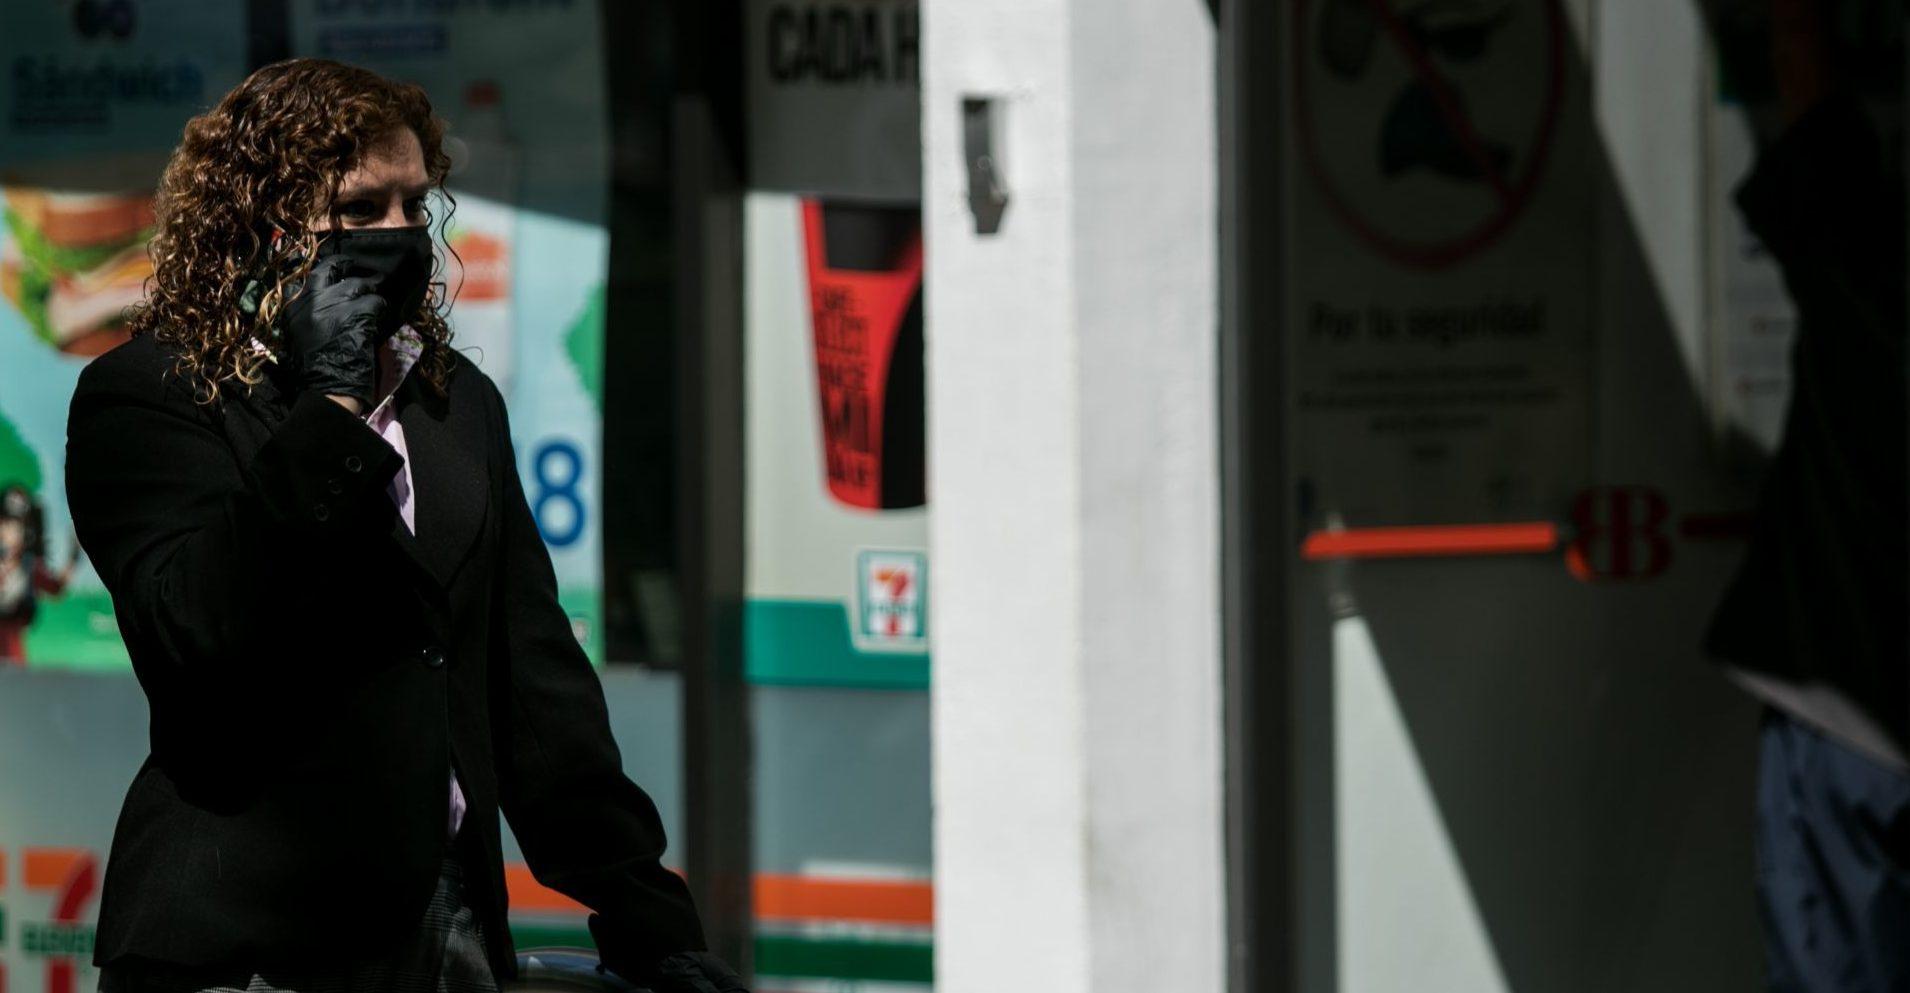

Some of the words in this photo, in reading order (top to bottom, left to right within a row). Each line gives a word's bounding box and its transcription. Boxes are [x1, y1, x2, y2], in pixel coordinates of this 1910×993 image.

[769, 7, 886, 82] CADA
[1306, 302, 1358, 340] Por
[1406, 294, 1546, 348] seguridad
[535, 441, 586, 546] 8
[21, 850, 97, 993] 7
